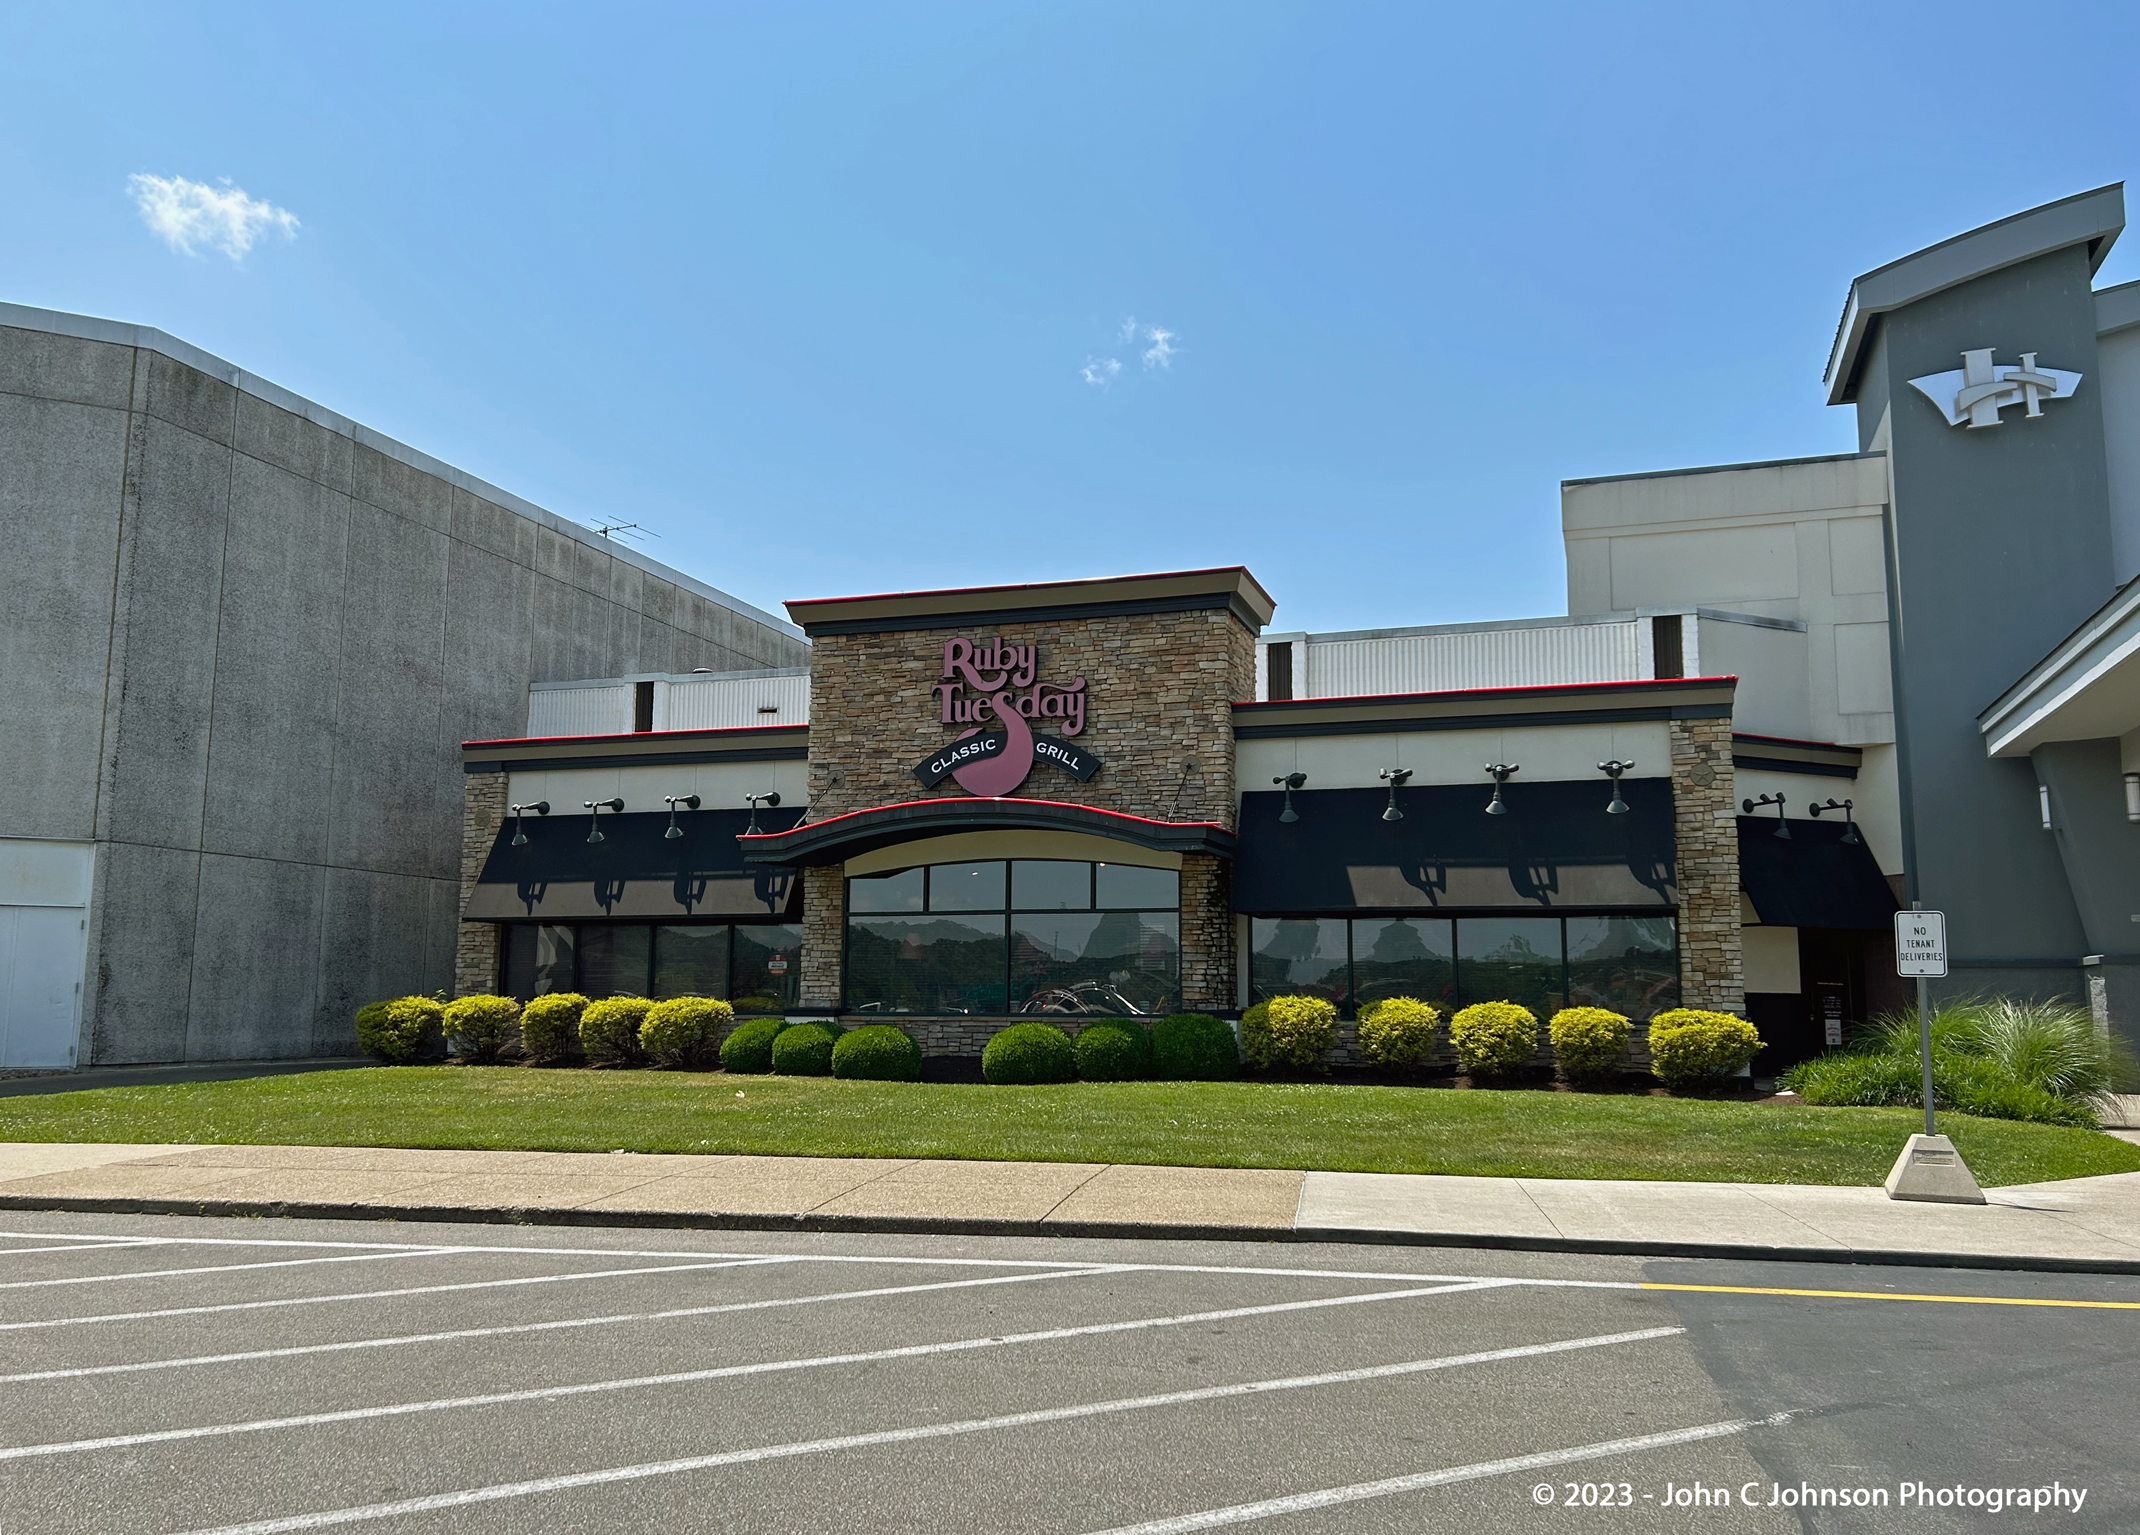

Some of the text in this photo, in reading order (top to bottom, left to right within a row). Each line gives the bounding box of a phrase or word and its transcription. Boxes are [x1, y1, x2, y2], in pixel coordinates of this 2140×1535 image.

[942, 637, 1037, 692] Ruby
[931, 676, 1087, 797] Tuesday
[931, 739, 1079, 774] CLASSIC GRILL
[1913, 926, 1927, 936] NO
[1906, 939, 1935, 949] TENANT
[1900, 952, 1943, 962] DELIVERIES
